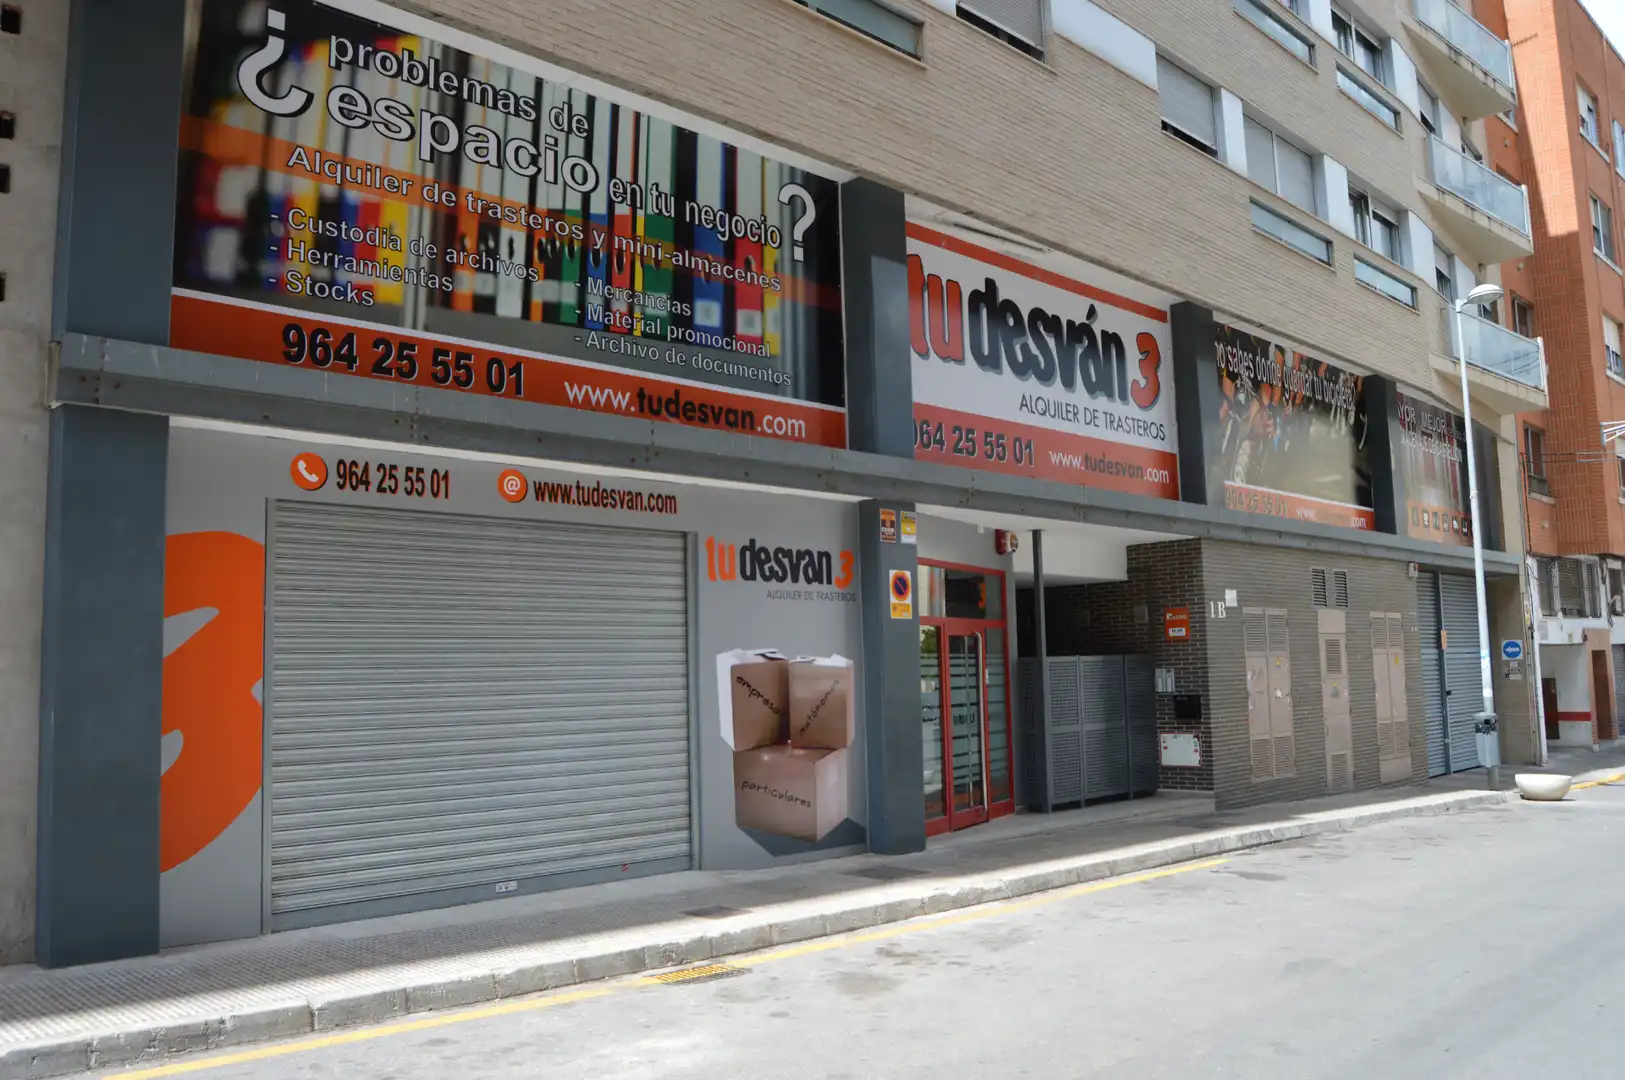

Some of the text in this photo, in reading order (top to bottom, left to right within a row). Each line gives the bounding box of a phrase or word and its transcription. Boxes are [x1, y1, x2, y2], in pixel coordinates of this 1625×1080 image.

[329, 34, 589, 138] problemas de
[326, 84, 599, 193] espacio
[608, 177, 644, 210] en
[650, 182, 675, 218] tu
[685, 199, 782, 250] negocio
[287, 145, 782, 292] Alquiler de trasteros y mini-almacenes
[287, 239, 454, 292] Herramientas
[288, 208, 402, 252] Custodia
[409, 237, 438, 259] de
[446, 246, 540, 282] archivos
[286, 270, 374, 307] Stocks
[587, 276, 691, 317] Mercancías
[587, 303, 660, 335] Material
[667, 323, 770, 358] promocional
[282, 323, 525, 397] 964 25 55 01
[586, 330, 659, 362] Archivo
[665, 347, 686, 367] de
[692, 348, 792, 386] documentos
[1227, 338, 1255, 379] sabes
[1256, 346, 1282, 387] donde
[564, 381, 806, 439] www.tudesvan.com
[1019, 393, 1166, 442] ALQUILER DE TRASTEROS
[914, 418, 1035, 467] 64 25 55 01
[1049, 450, 1170, 484] www.tudesvan.com
[336, 459, 451, 499] 964 25 55 01
[533, 479, 678, 514] www.tudesvan.com
[766, 589, 857, 602] ALQUILER DE TRASTEROS
[741, 780, 811, 808] particulares
